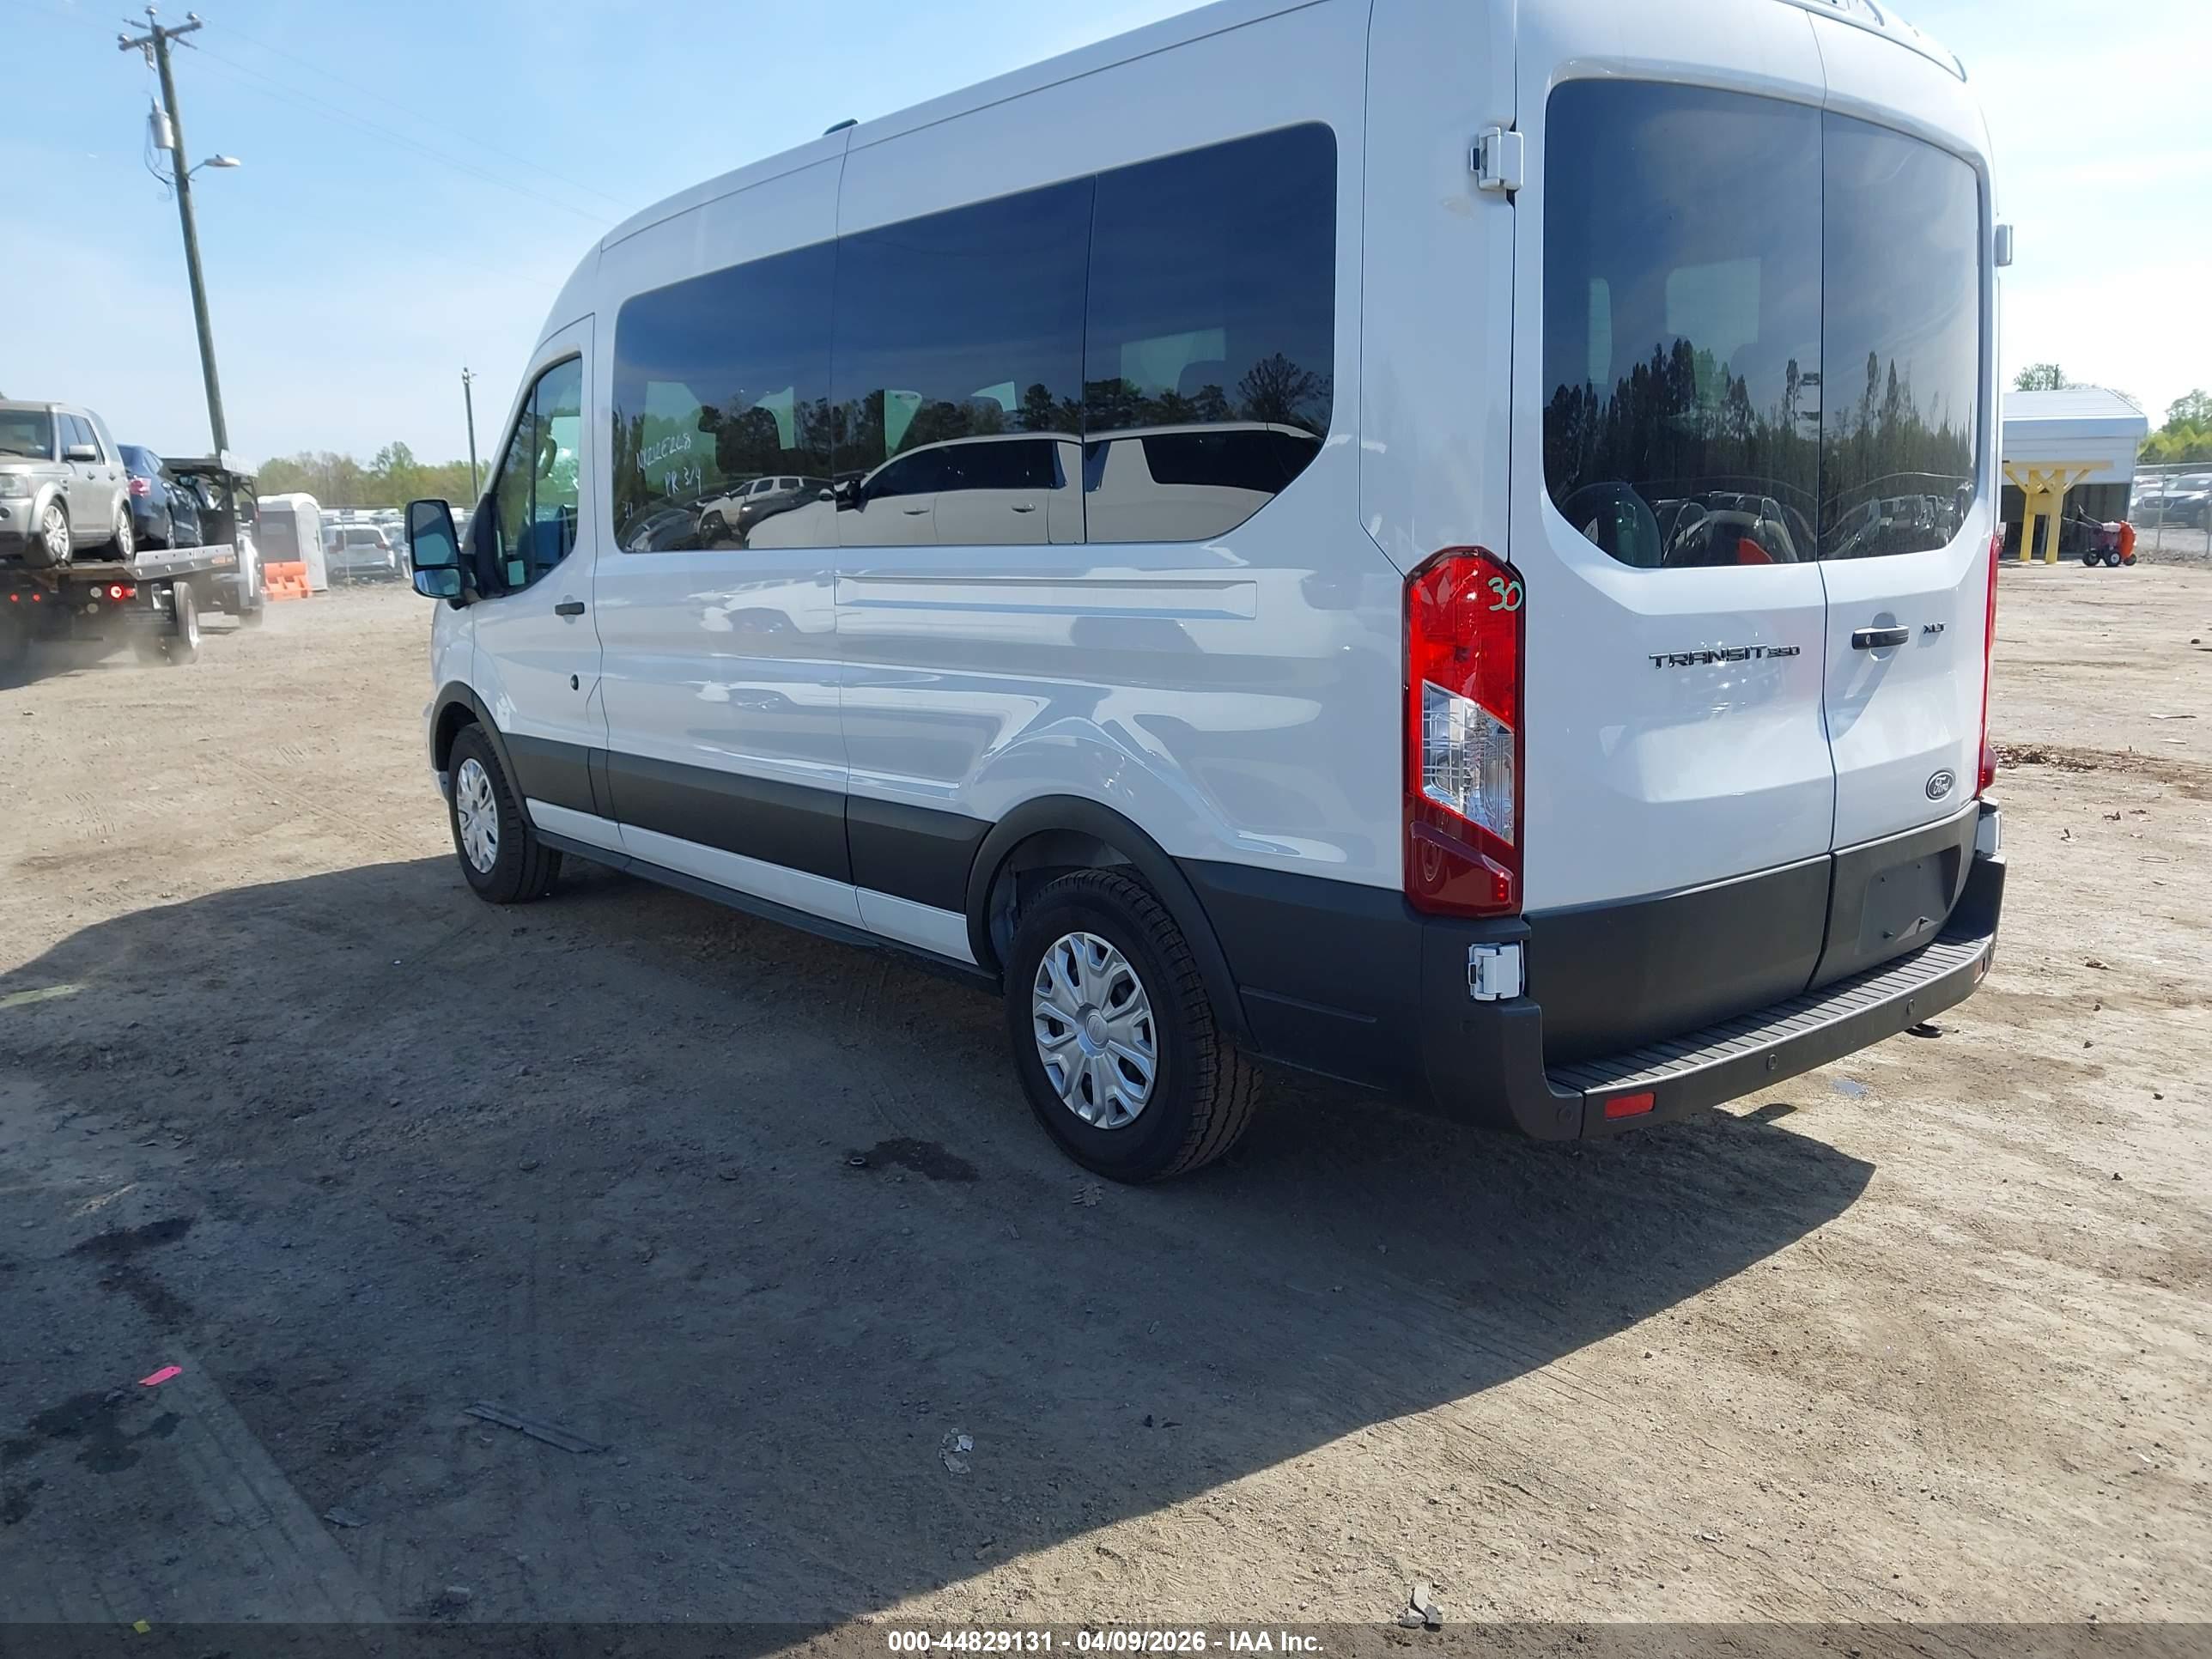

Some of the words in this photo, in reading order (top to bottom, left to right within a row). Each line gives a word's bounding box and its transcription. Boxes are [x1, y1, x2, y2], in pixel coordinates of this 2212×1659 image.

[665, 471, 680, 497] PR
[683, 466, 702, 496] 3/4
[1487, 576, 1523, 611] 30
